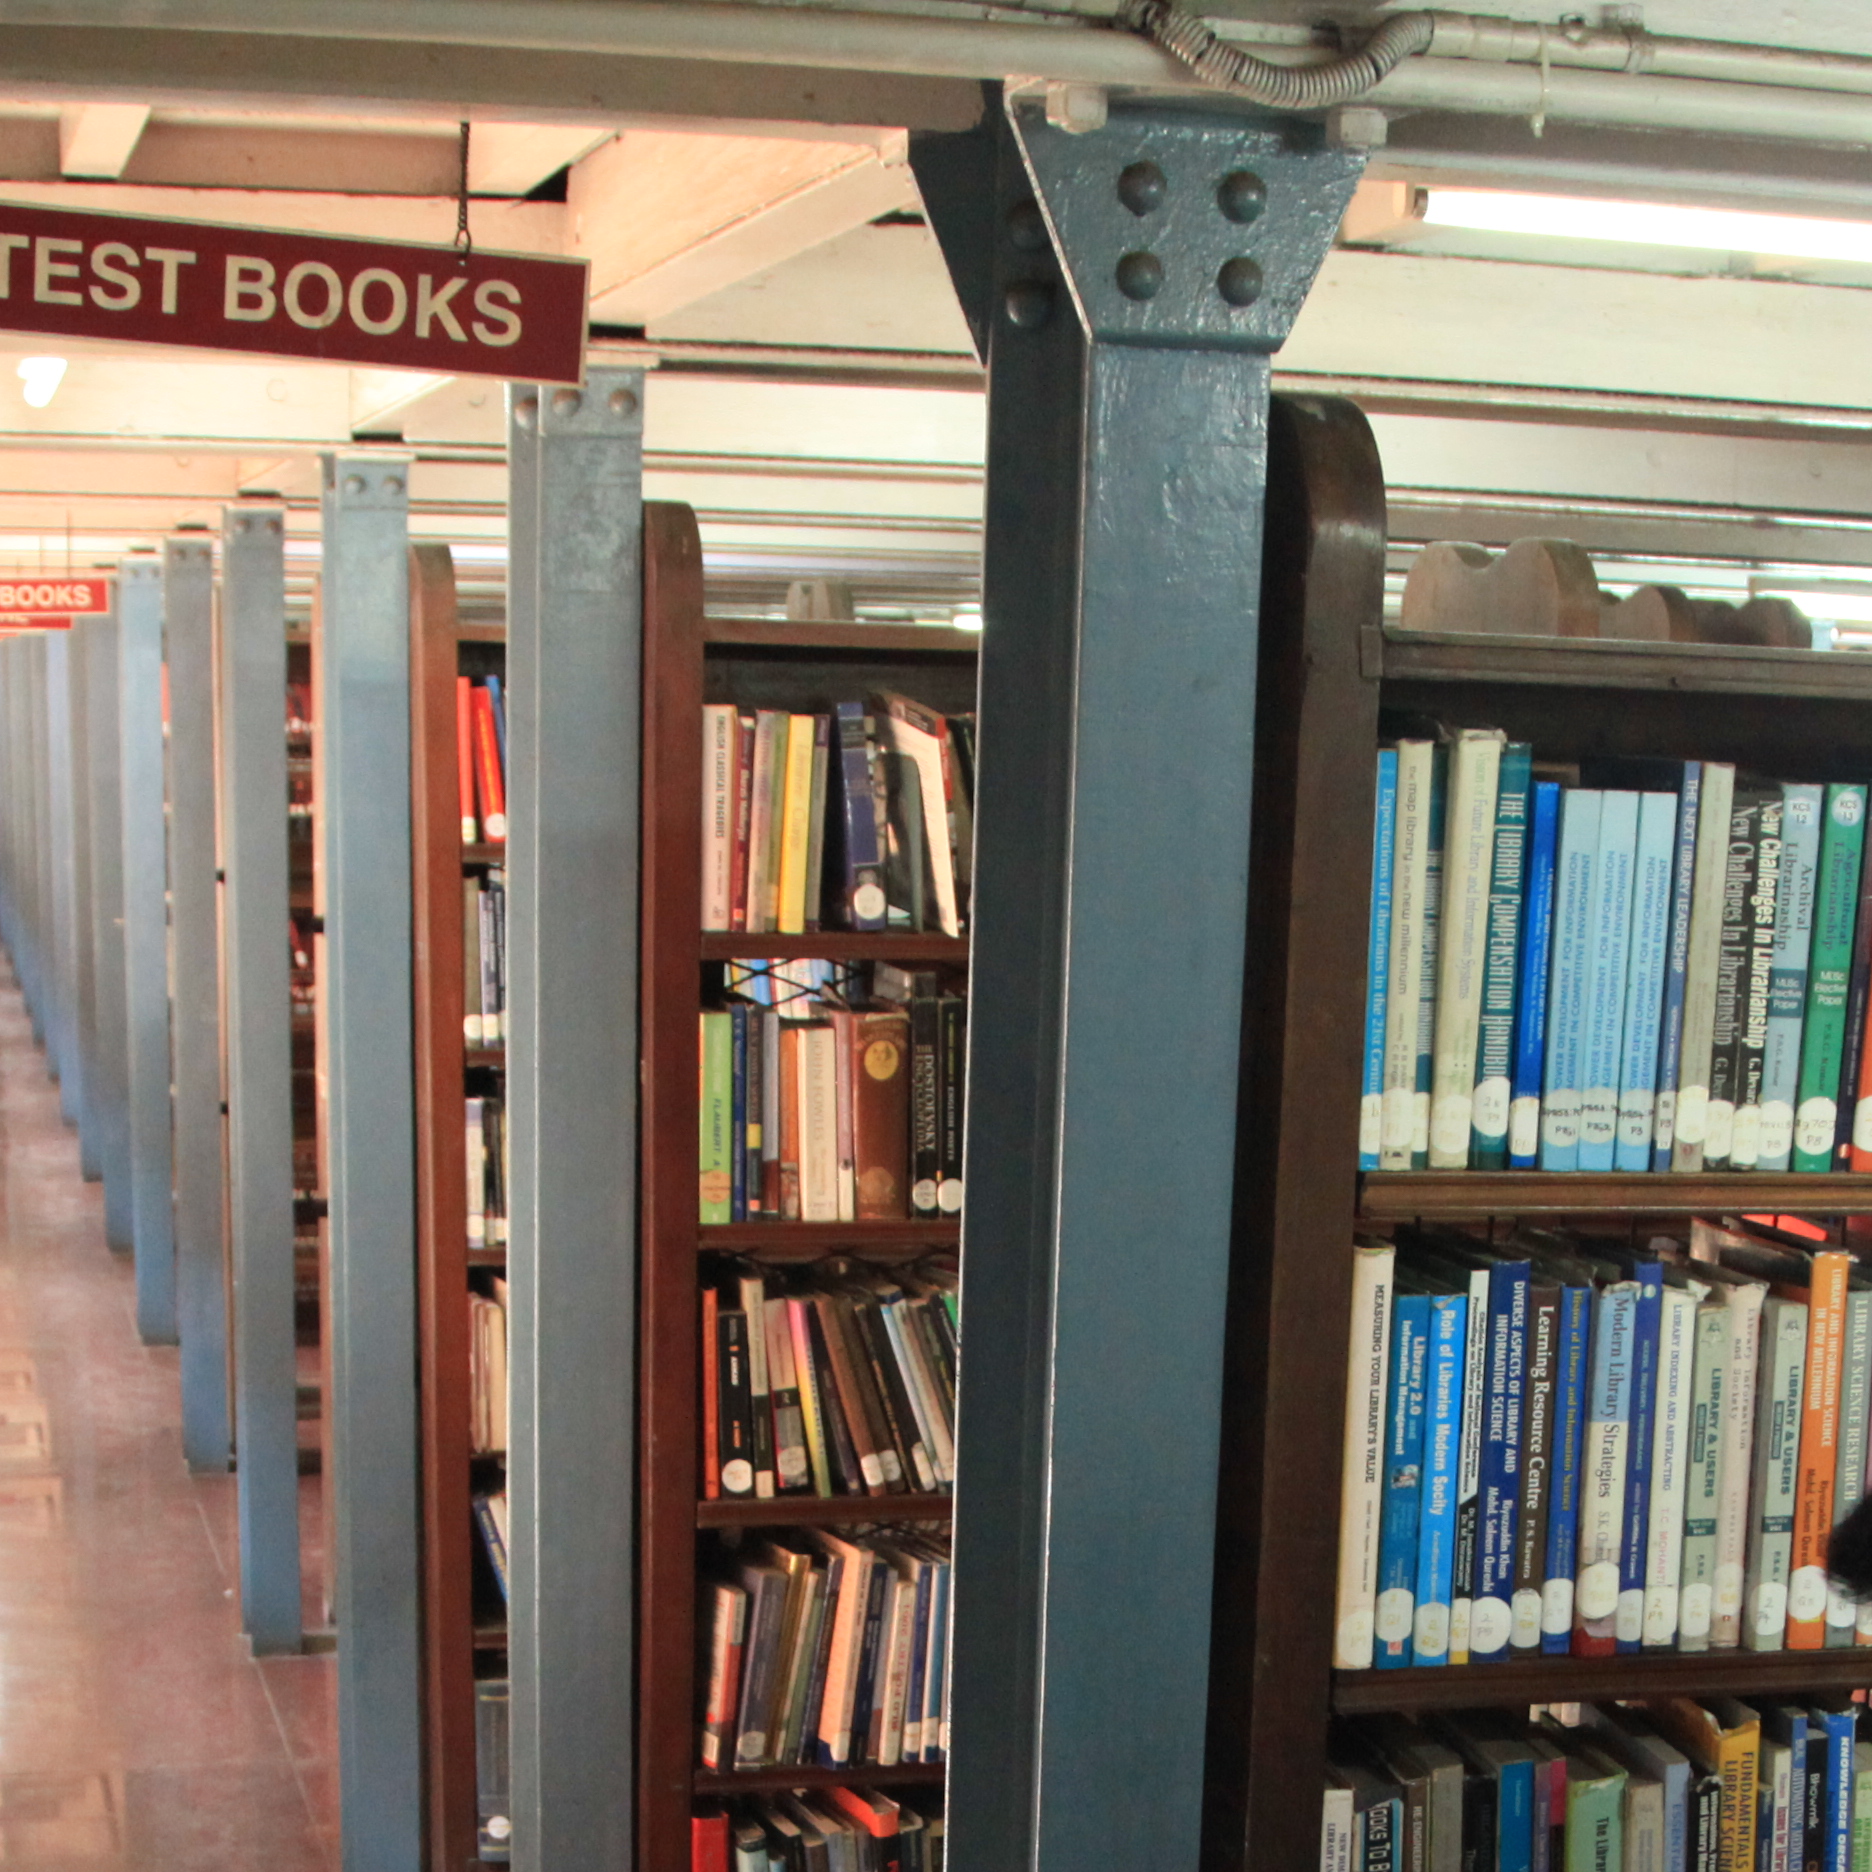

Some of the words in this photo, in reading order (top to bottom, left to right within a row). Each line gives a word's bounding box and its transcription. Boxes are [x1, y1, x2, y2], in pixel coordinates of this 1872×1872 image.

[223, 255, 524, 347] BOOKS
[716, 716, 726, 747] ENGLISH
[716, 749, 726, 791] CLASSICAL
[1409, 767, 1417, 779] the
[1686, 780, 1698, 802] THE
[715, 794, 726, 838] TRAGEDIES
[1404, 783, 1415, 812] map
[1499, 792, 1524, 818] THE
[1759, 802, 1781, 831] New
[1791, 803, 1810, 813] KCS
[1796, 813, 1807, 824] 12
[1838, 801, 1856, 811] KCS
[1842, 812, 1853, 822] 13
[1376, 789, 1394, 878] Expectations
[1401, 817, 1417, 861] library
[1683, 808, 1695, 840] NEXT
[1404, 864, 1412, 873] in
[1494, 825, 1522, 888] LIBRARY
[1679, 846, 1692, 894] LIBRARY
[1378, 883, 1390, 896] of
[1403, 876, 1411, 889] the
[1749, 837, 1779, 924] Challenges
[1778, 843, 1797, 951] Librarinaship
[1797, 864, 1812, 931] Archival
[1824, 842, 1844, 951] Librarianship
[1837, 848, 1856, 945] Agricultural
[1401, 893, 1411, 919] new
[1375, 901, 1389, 971] Librarians
[1486, 895, 1517, 1009] COMPENSATION
[1673, 899, 1688, 972] LEADERSHIP
[1753, 929, 1772, 942] In
[1398, 924, 1413, 994] millennium
[1373, 994, 1385, 1014] the
[1374, 976, 1386, 989] in
[1742, 947, 1771, 1048] Librarianship
[1372, 1019, 1384, 1045] 21st
[813, 1040, 825, 1074] JOHN
[812, 1081, 824, 1141] FOWLES
[916, 1055, 925, 1152] ENCYCLOPEDIA
[925, 1055, 936, 1150] DOSTOEVSKY
[1371, 1285, 1384, 1352] MEASURING
[1441, 1310, 1455, 1339] Role
[1511, 1281, 1524, 1327] DIVERSE
[1671, 1304, 1682, 1346] LIBRARY
[1530, 1306, 1554, 1377] Learning
[1610, 1298, 1629, 1357] Modern
[1851, 1300, 1868, 1361] LIBRARY
[1370, 1356, 1381, 1385] YOUR
[1409, 1337, 1425, 1387] Library
[1440, 1345, 1454, 1357] of
[1492, 1315, 1507, 1393] INFORMATION
[1509, 1331, 1522, 1376] ASPECTS
[1668, 1351, 1679, 1397] INDEXING
[1410, 1392, 1422, 1415] 2.0
[1437, 1363, 1453, 1418] Libraries
[1508, 1381, 1519, 1395] OF
[1601, 1363, 1624, 1418] Library
[1667, 1401, 1677, 1420] AND
[1708, 1368, 1721, 1429] LIBRARY
[1848, 1366, 1864, 1424] SCIENCE
[1367, 1389, 1379, 1447] LIBRARY'S
[1489, 1396, 1503, 1441] SCIENCE
[1506, 1399, 1518, 1444] LIBRARY
[1530, 1382, 1549, 1451] Resource
[1708, 1434, 1717, 1443] &
[1365, 1451, 1376, 1482] VALUE
[1435, 1424, 1450, 1471] Modern
[1504, 1449, 1516, 1473] AND
[1595, 1424, 1618, 1497] Strategies
[1662, 1424, 1675, 1491] ABSTRACTING
[1844, 1428, 1861, 1500] RESEARCH
[1527, 1456, 1545, 1509] Centre
[1704, 1447, 1716, 1497] USERS
[1429, 1476, 1447, 1515] Socity
[1722, 1760, 1736, 1821] LIBRARY
[1809, 1773, 1819, 1829] Bhowmik
[1837, 1737, 1849, 1828] KNOWLEDGE
[1596, 1817, 1608, 1835] The
[1736, 1752, 1754, 1869] FUNDAMENTALS
